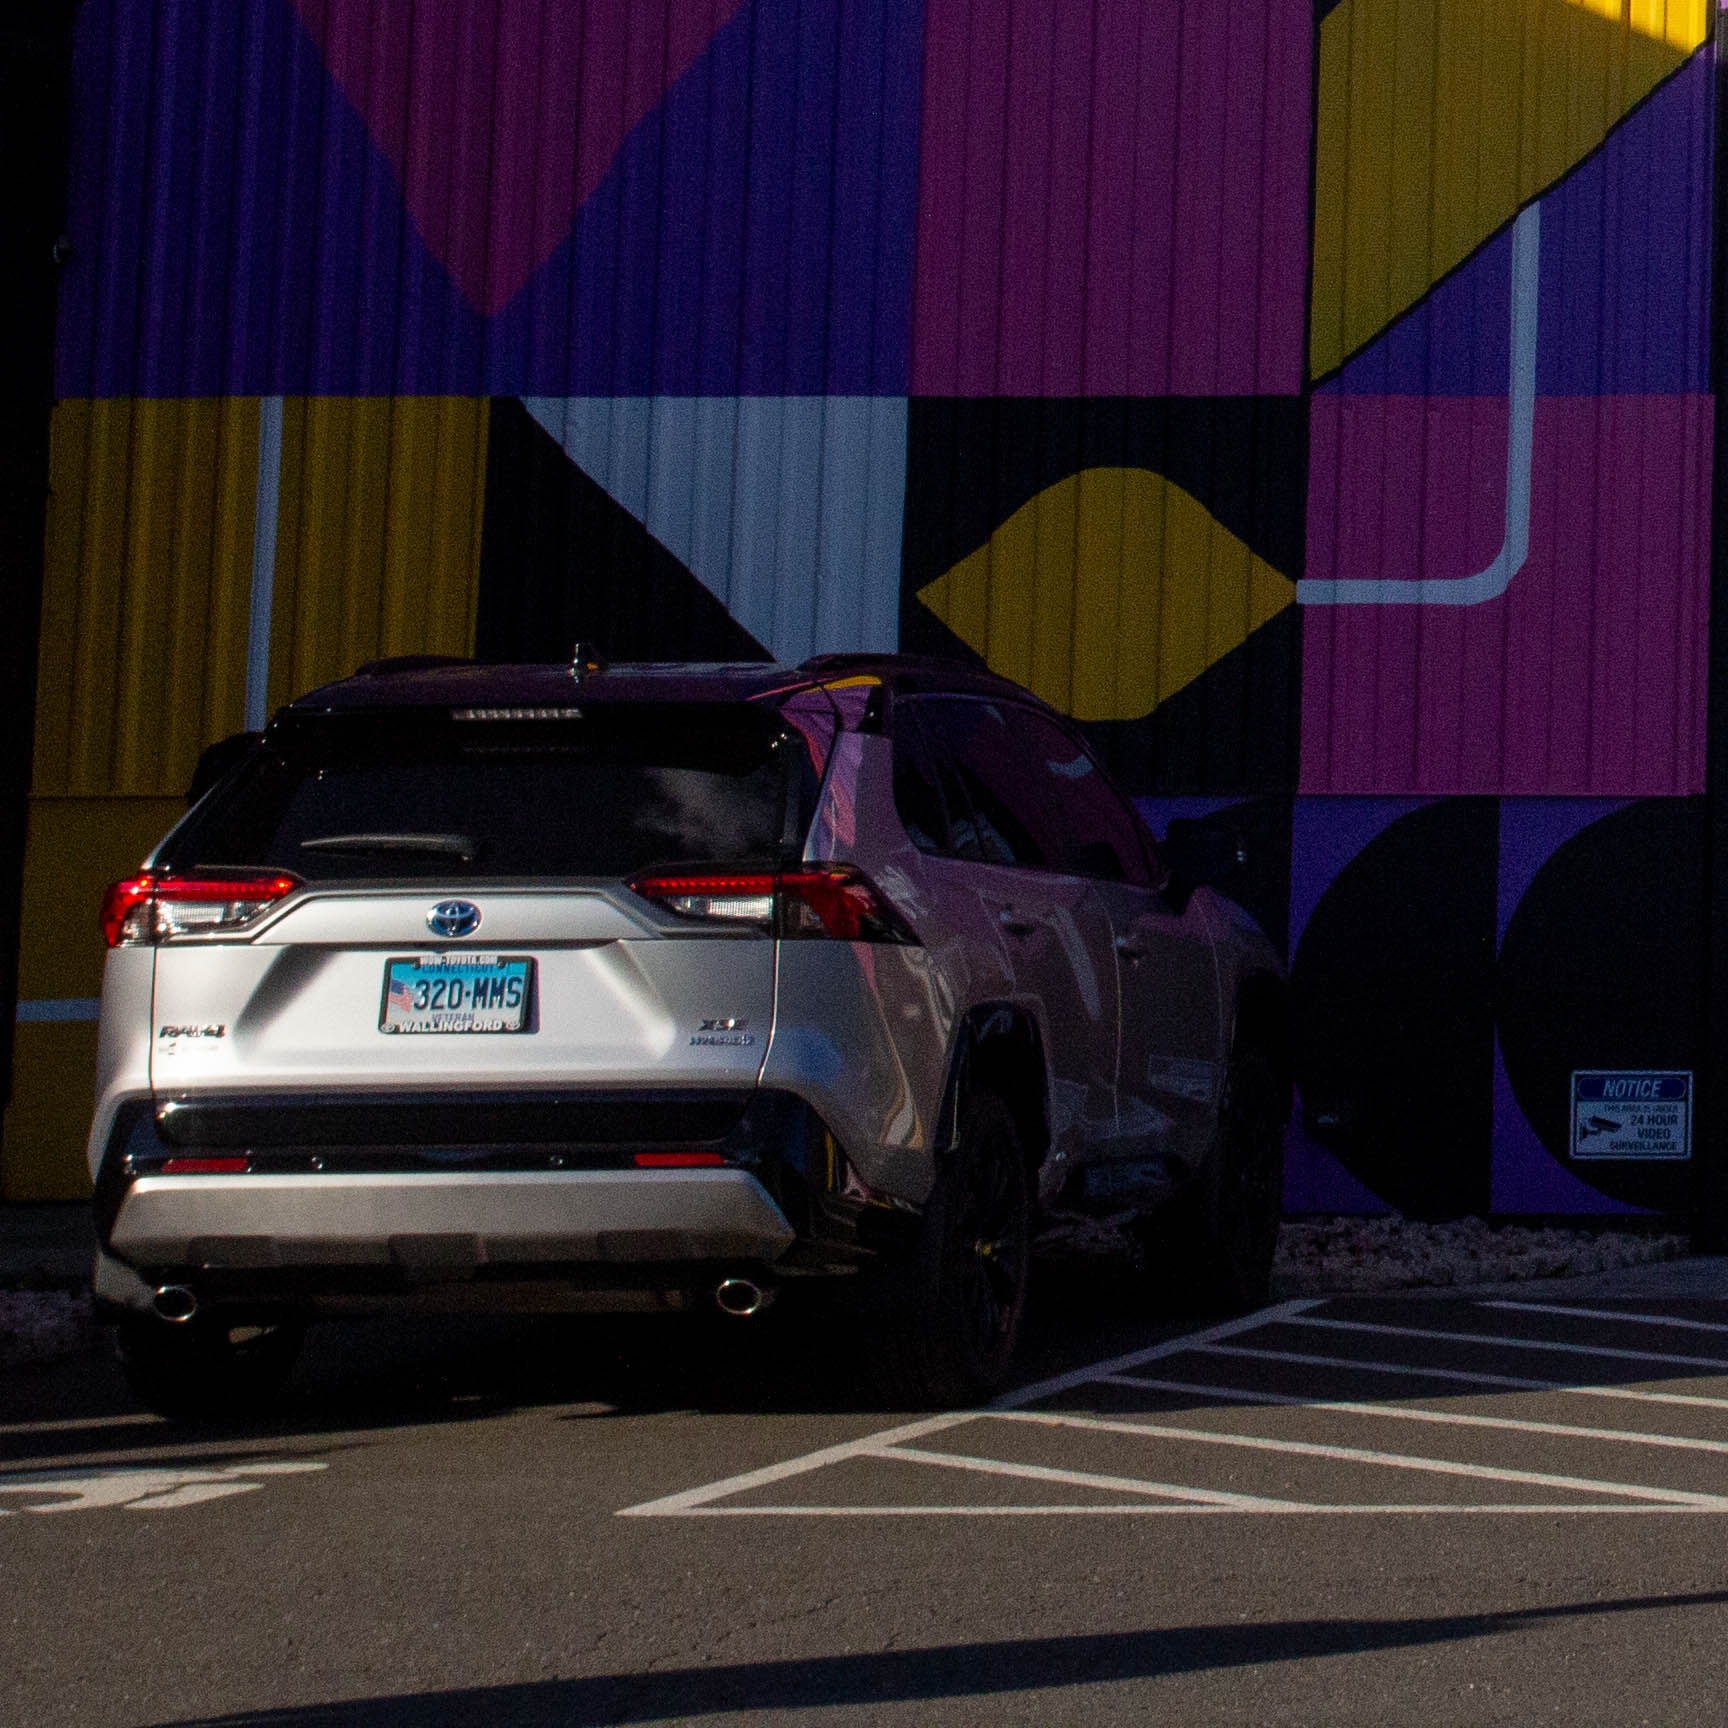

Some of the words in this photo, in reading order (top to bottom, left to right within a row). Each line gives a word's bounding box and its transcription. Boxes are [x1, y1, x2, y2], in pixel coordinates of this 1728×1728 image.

[421, 964, 495, 975] CONNECTICUT
[399, 1020, 503, 1033] WALLINGFORD
[1602, 1079, 1663, 1098] NOTICE
[1630, 1114, 1644, 1126] 24
[1647, 1114, 1679, 1126] HOUR
[1637, 1127, 1671, 1139] VIDEO
[1609, 1140, 1678, 1151] SURVEILLANCE
